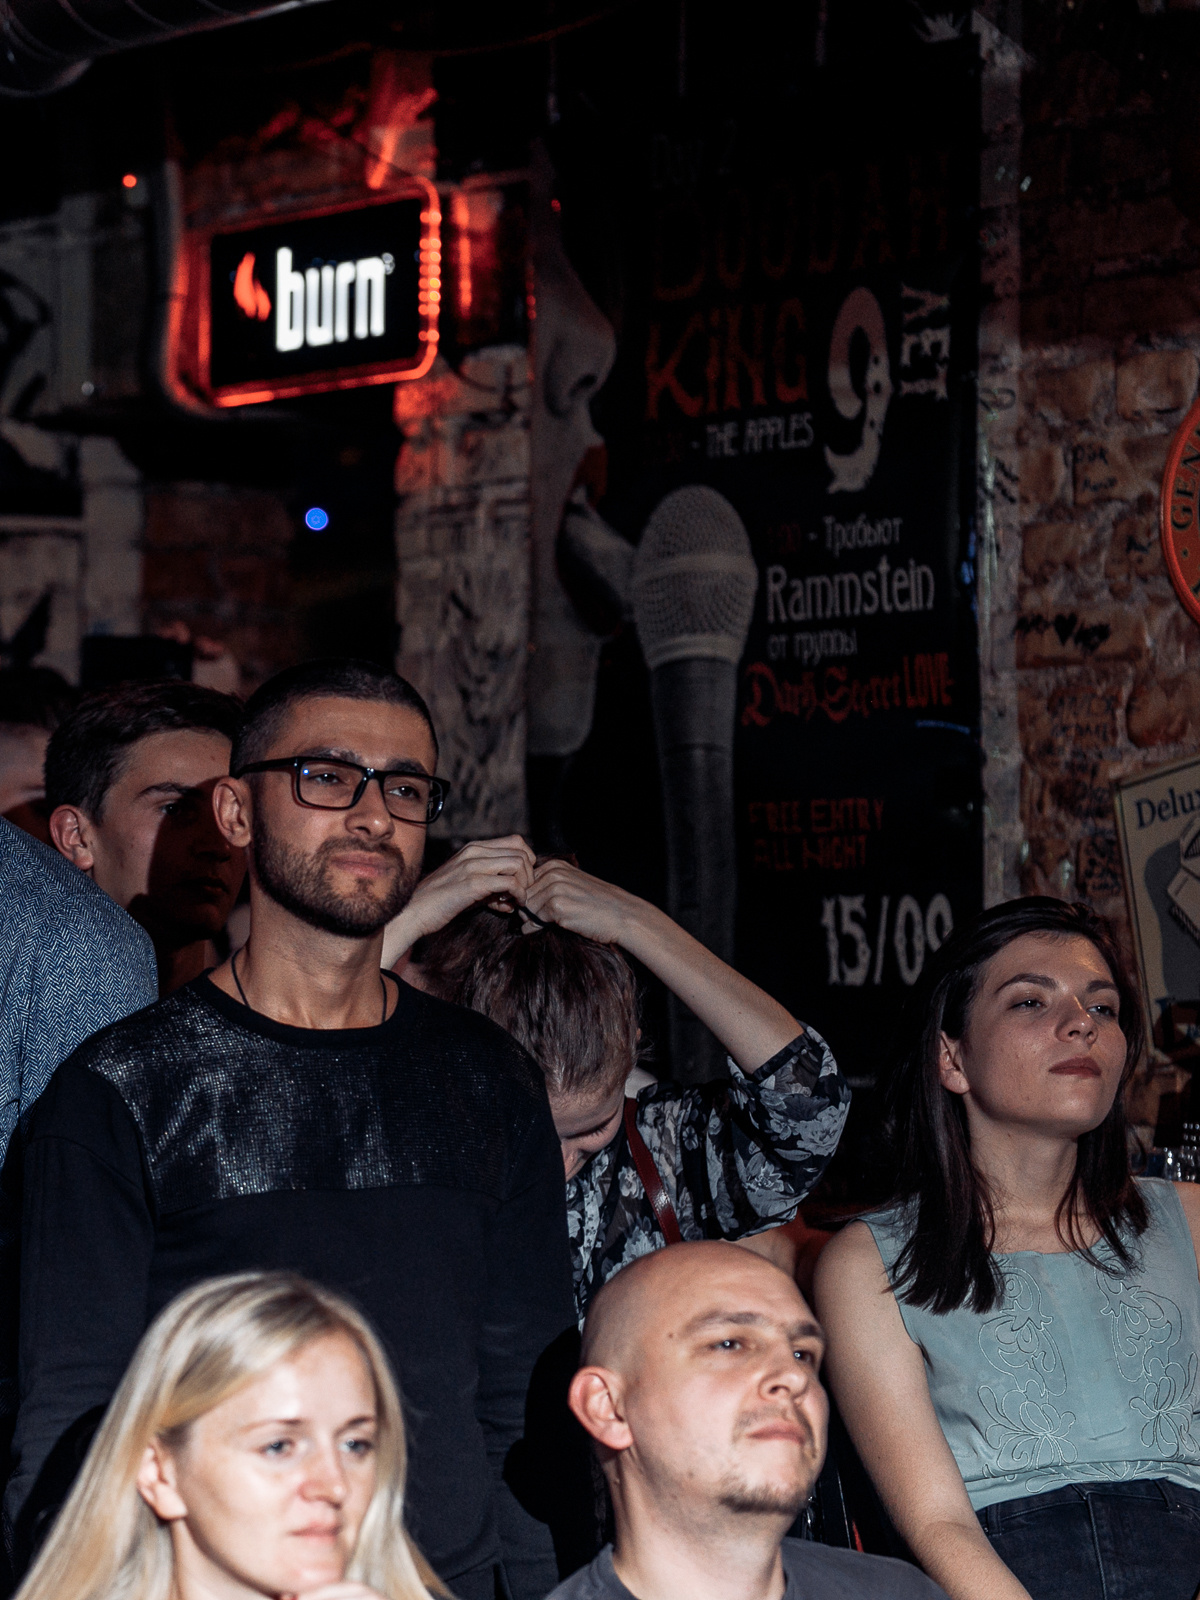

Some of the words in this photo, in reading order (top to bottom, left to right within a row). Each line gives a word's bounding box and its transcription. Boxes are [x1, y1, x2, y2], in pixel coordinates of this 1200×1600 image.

[823, 286, 896, 495] 9
[703, 420, 739, 461] THE
[741, 411, 816, 457] APPLES
[766, 554, 936, 624] Rammstein
[766, 634, 789, 661] от
[792, 627, 859, 668] группы
[746, 799, 803, 835] FREE
[808, 796, 885, 835] ENTRY
[1135, 786, 1200, 831] Delu
[752, 837, 795, 872] ALL
[801, 833, 867, 872] NIGHT
